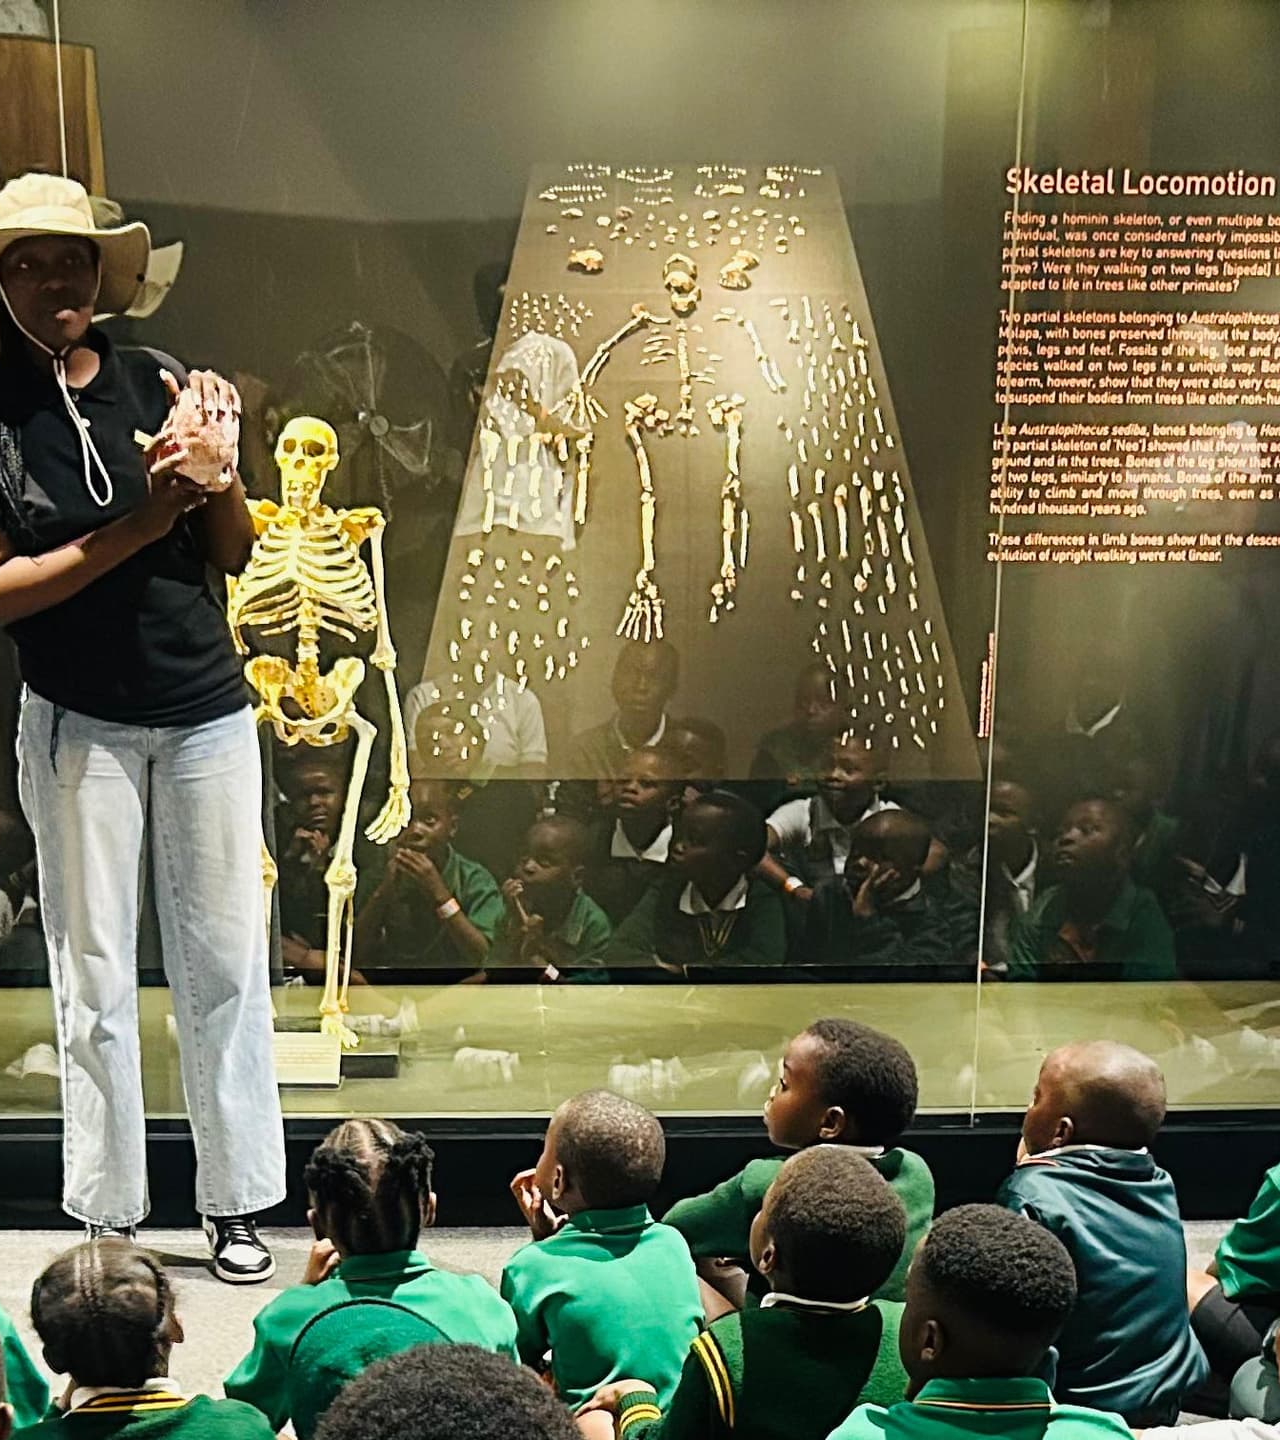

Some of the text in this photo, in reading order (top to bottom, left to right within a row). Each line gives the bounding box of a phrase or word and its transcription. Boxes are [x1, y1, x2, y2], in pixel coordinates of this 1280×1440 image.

[1006, 168, 1275, 195] Skeletal Locomotion
[1062, 212, 1108, 224] hominin
[1168, 215, 1181, 225] or
[1185, 215, 1212, 225] even
[1216, 213, 1263, 229] multiple
[1064, 231, 1087, 241] was
[1091, 231, 1119, 241] once
[1123, 229, 1186, 242] considered
[1190, 229, 1226, 245] nearly
[1041, 245, 1095, 257] skeletons
[1098, 248, 1117, 258] are
[1119, 245, 1139, 261] key
[1141, 246, 1152, 258] to
[1155, 246, 1214, 261] answering
[1216, 246, 1270, 262] questions
[1042, 261, 1071, 273] Were
[1103, 261, 1147, 277] walking
[1151, 264, 1165, 274] on
[1170, 262, 1190, 274] two
[1194, 262, 1218, 278] legs
[1048, 277, 1059, 290] to
[1062, 277, 1079, 290] life
[1081, 278, 1092, 290] in
[1095, 278, 1124, 290] trees
[1126, 278, 1147, 290] like
[1149, 278, 1180, 290] other
[1023, 310, 1060, 325] partial
[1063, 310, 1116, 323] skeletons
[1118, 310, 1173, 326] belonging
[1175, 311, 1187, 323] to
[1045, 326, 1069, 339] with
[1072, 326, 1106, 339] bones
[1108, 327, 1164, 342] preserved
[1231, 327, 1249, 340] the
[1036, 342, 1060, 358] legs
[1064, 343, 1085, 355] and
[1118, 343, 1157, 355] Fossils
[1161, 343, 1173, 356] of
[1176, 343, 1195, 356] the
[1224, 343, 1245, 356] foot
[1248, 343, 1271, 356] and
[1043, 359, 1083, 371] walked
[1087, 361, 1102, 371] on
[1107, 359, 1128, 371] two
[1132, 359, 1156, 374] legs
[1161, 359, 1172, 371] in
[1189, 359, 1227, 375] unique
[1098, 375, 1129, 387] show
[1130, 375, 1153, 387] that
[1155, 375, 1180, 391] they
[1181, 378, 1209, 388] were
[1211, 375, 1236, 388] also
[1238, 378, 1262, 391] very
[1006, 390, 1055, 406] suspend
[1058, 391, 1085, 403] their
[1086, 391, 1123, 403] bodies
[1125, 391, 1152, 403] from
[1154, 391, 1184, 404] trees
[1186, 391, 1206, 404] like
[1208, 391, 1239, 404] other
[1024, 533, 1085, 545] differences
[1088, 533, 1099, 545] in
[1102, 533, 1127, 545] limb
[1129, 533, 1164, 545] bones
[1166, 533, 1197, 545] show
[1199, 533, 1221, 545] that
[1224, 533, 1243, 545] the
[1038, 548, 1050, 560] of
[1051, 548, 1092, 563] upright
[1093, 548, 1137, 564] walking
[1138, 551, 1166, 561] were
[1167, 548, 1186, 561] not
